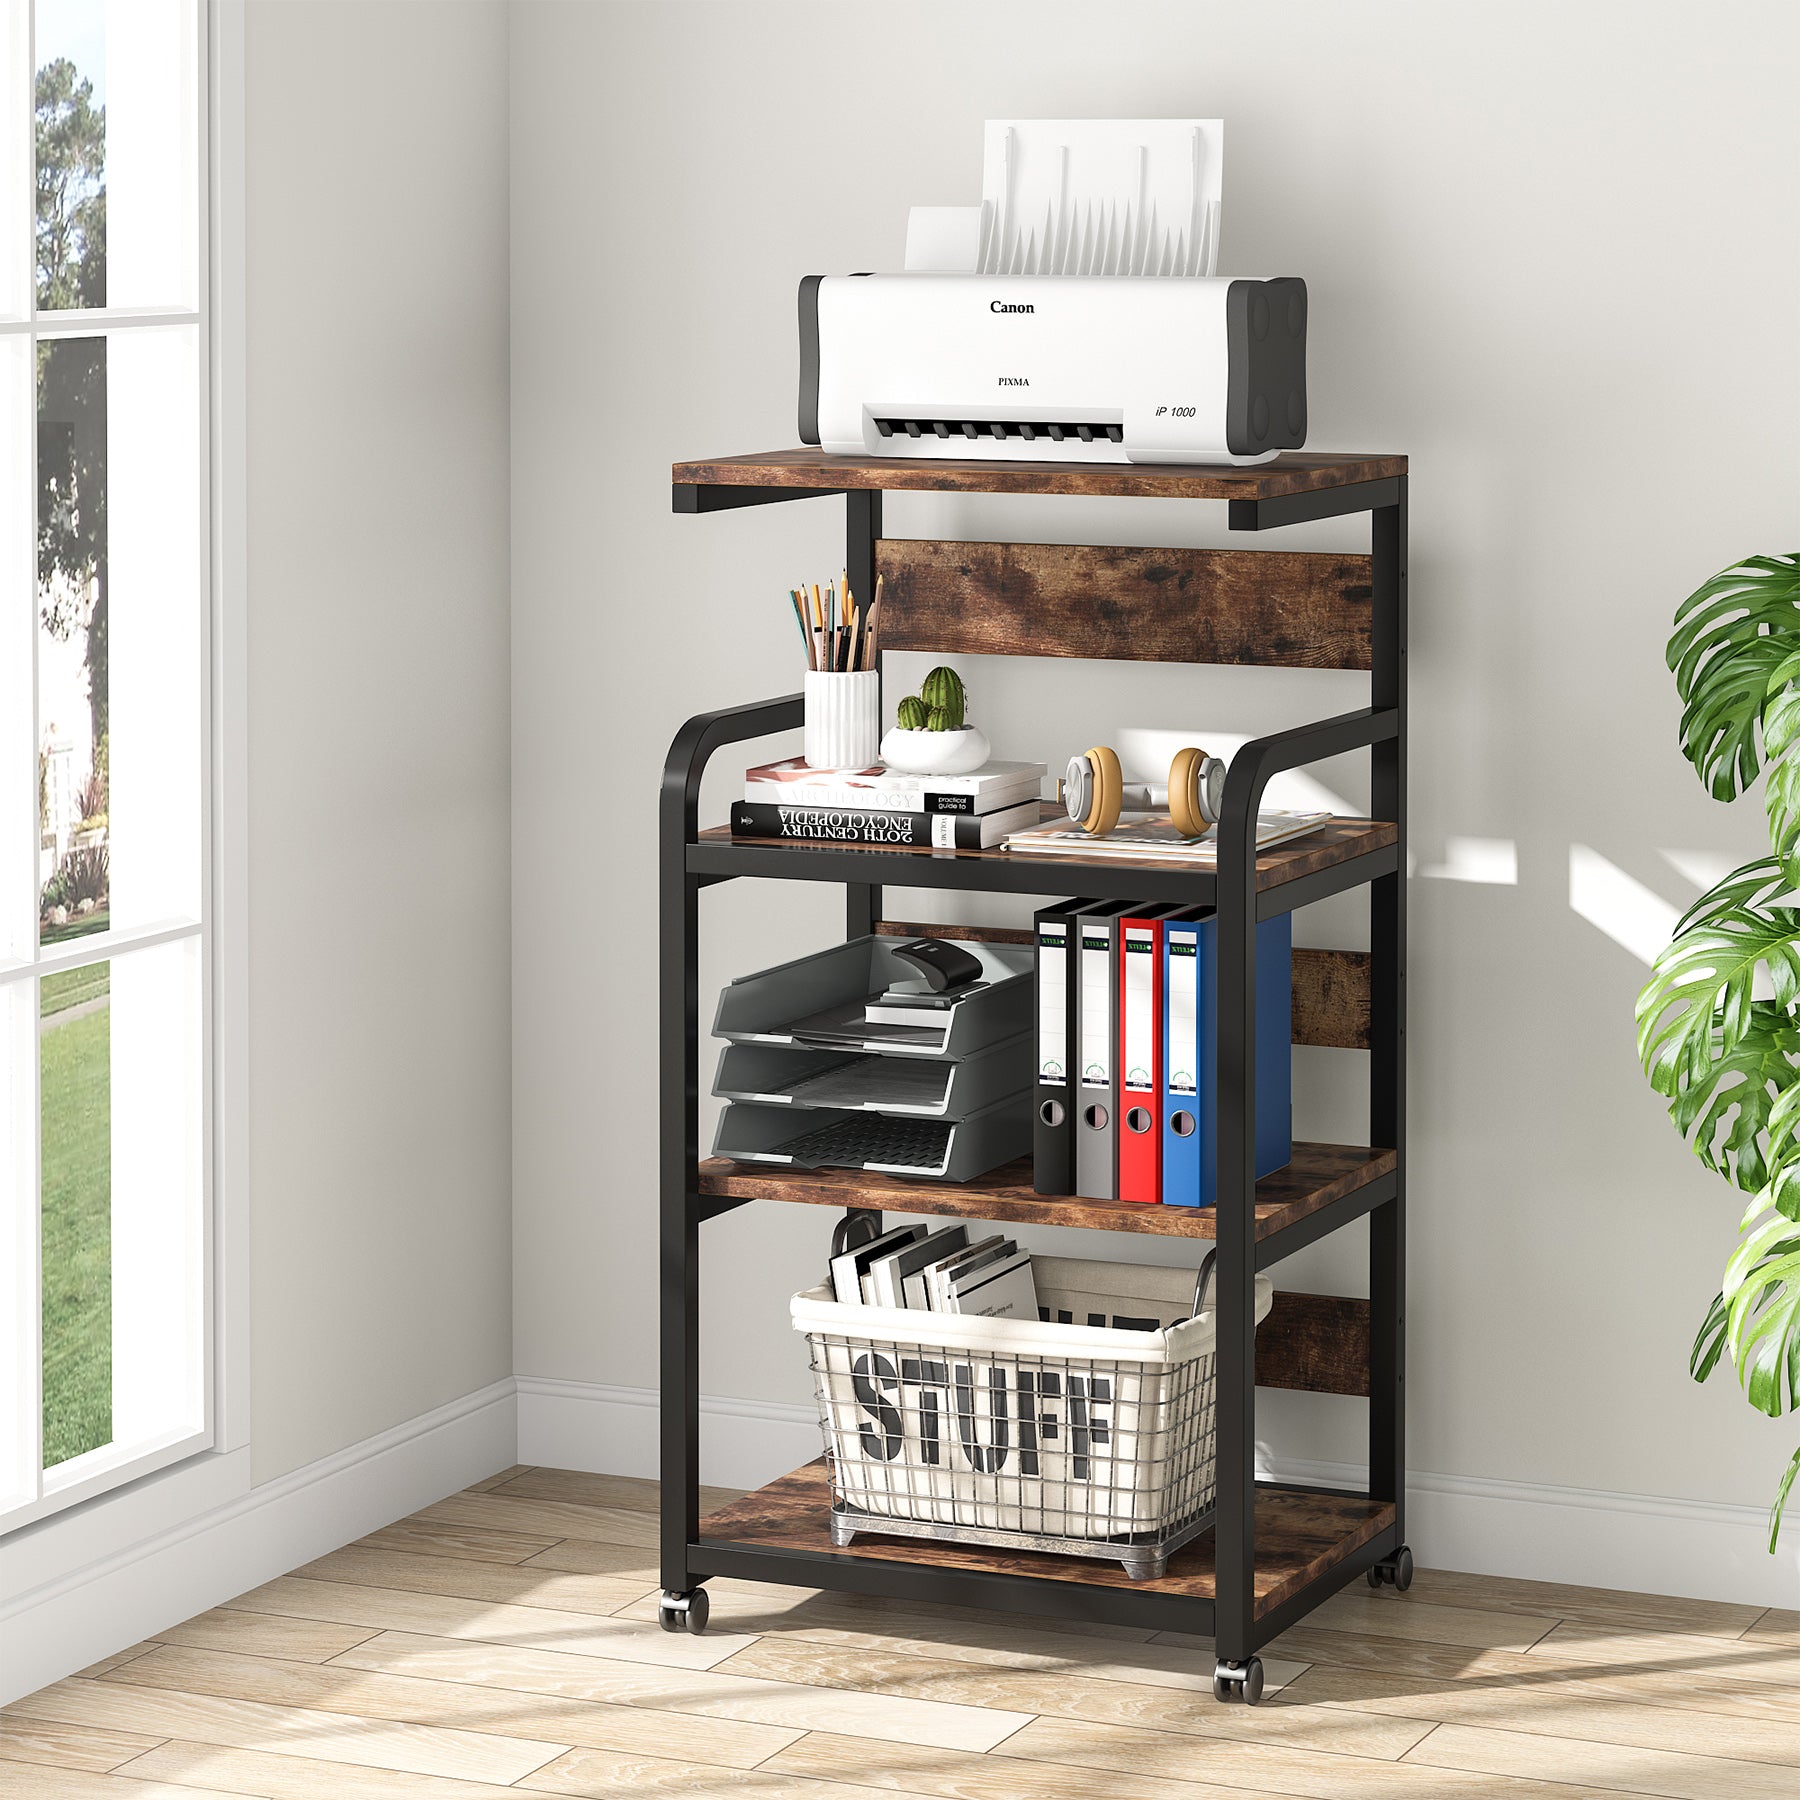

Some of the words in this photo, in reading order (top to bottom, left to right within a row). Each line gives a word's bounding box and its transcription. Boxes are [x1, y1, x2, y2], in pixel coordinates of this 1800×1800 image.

[990, 300, 1035, 314] Canon
[998, 377, 1030, 387] PIXMA
[1155, 406, 1168, 418] iP
[1170, 406, 1197, 418] 1000
[790, 788, 914, 809] ARCHEOLOGY
[938, 796, 967, 804] practical
[777, 809, 914, 832] ENCYCLOPEDIA
[780, 823, 859, 840] CENTURY
[863, 828, 914, 843] 20TH
[940, 817, 948, 842] VOLUME
[852, 1353, 1112, 1480] STUFF
